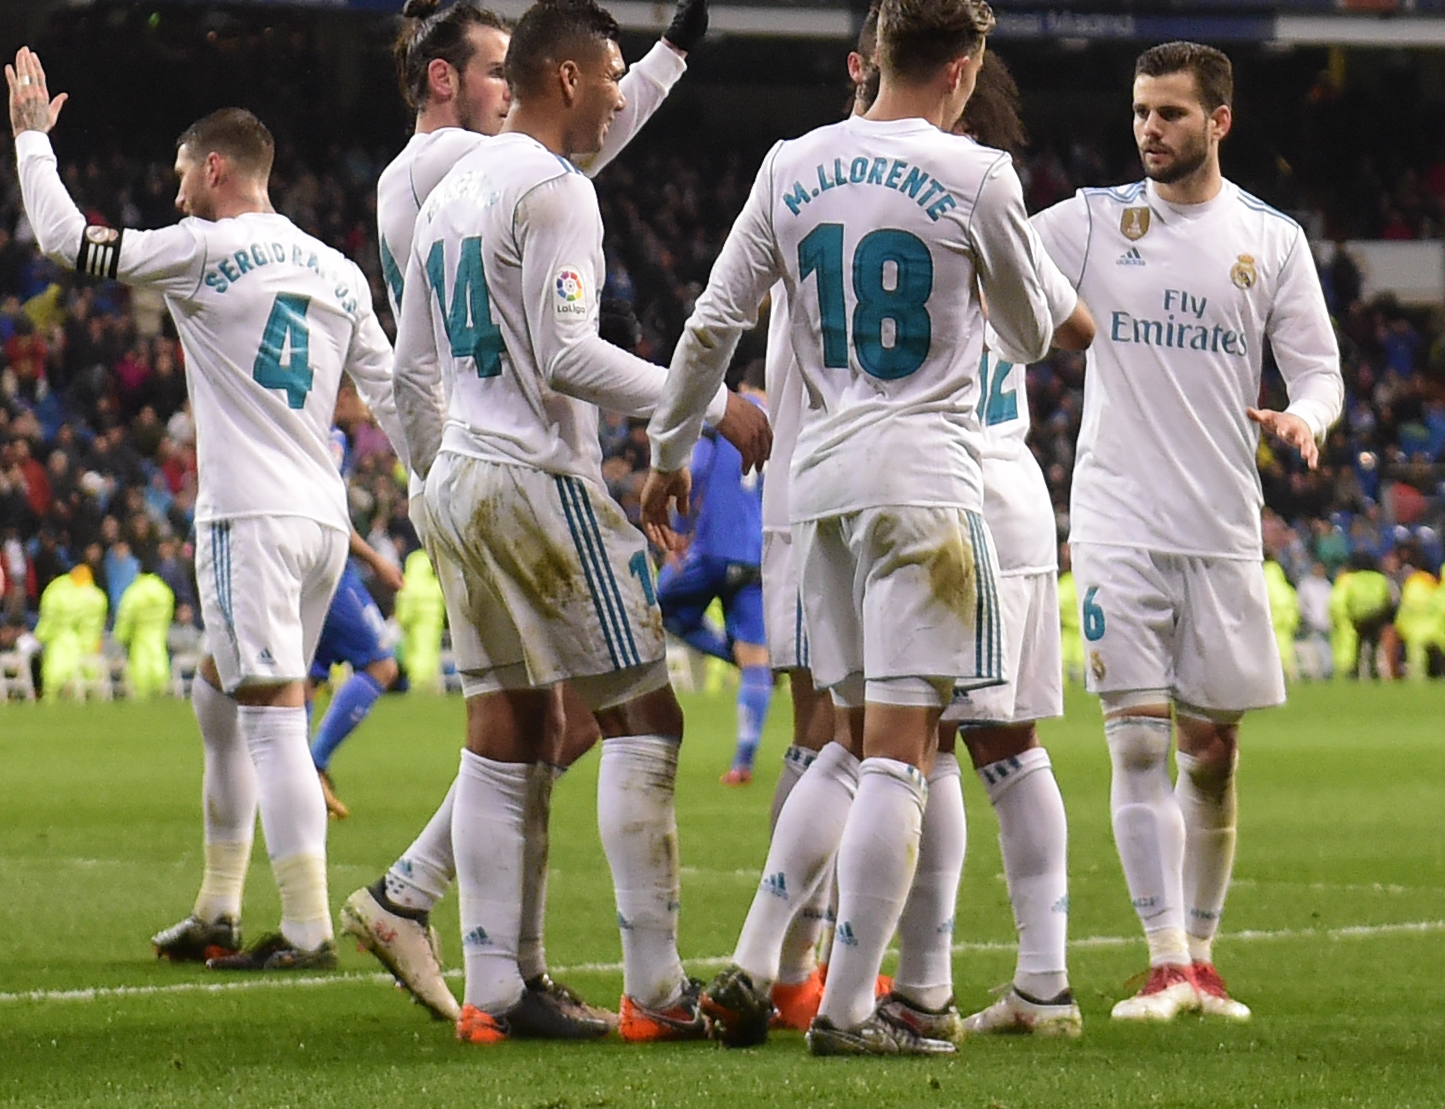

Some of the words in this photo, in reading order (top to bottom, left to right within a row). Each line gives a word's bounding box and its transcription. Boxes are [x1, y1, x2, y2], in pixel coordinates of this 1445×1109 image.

[783, 157, 957, 222] M.LLORENTE
[205, 243, 285, 293] SERGIO
[557, 304, 585, 315] LaLiga
[797, 222, 933, 380] 18
[1164, 289, 1207, 319] Fly
[253, 291, 313, 410] 4
[1111, 311, 1247, 357] Emirates
[1083, 586, 1105, 641] 6
